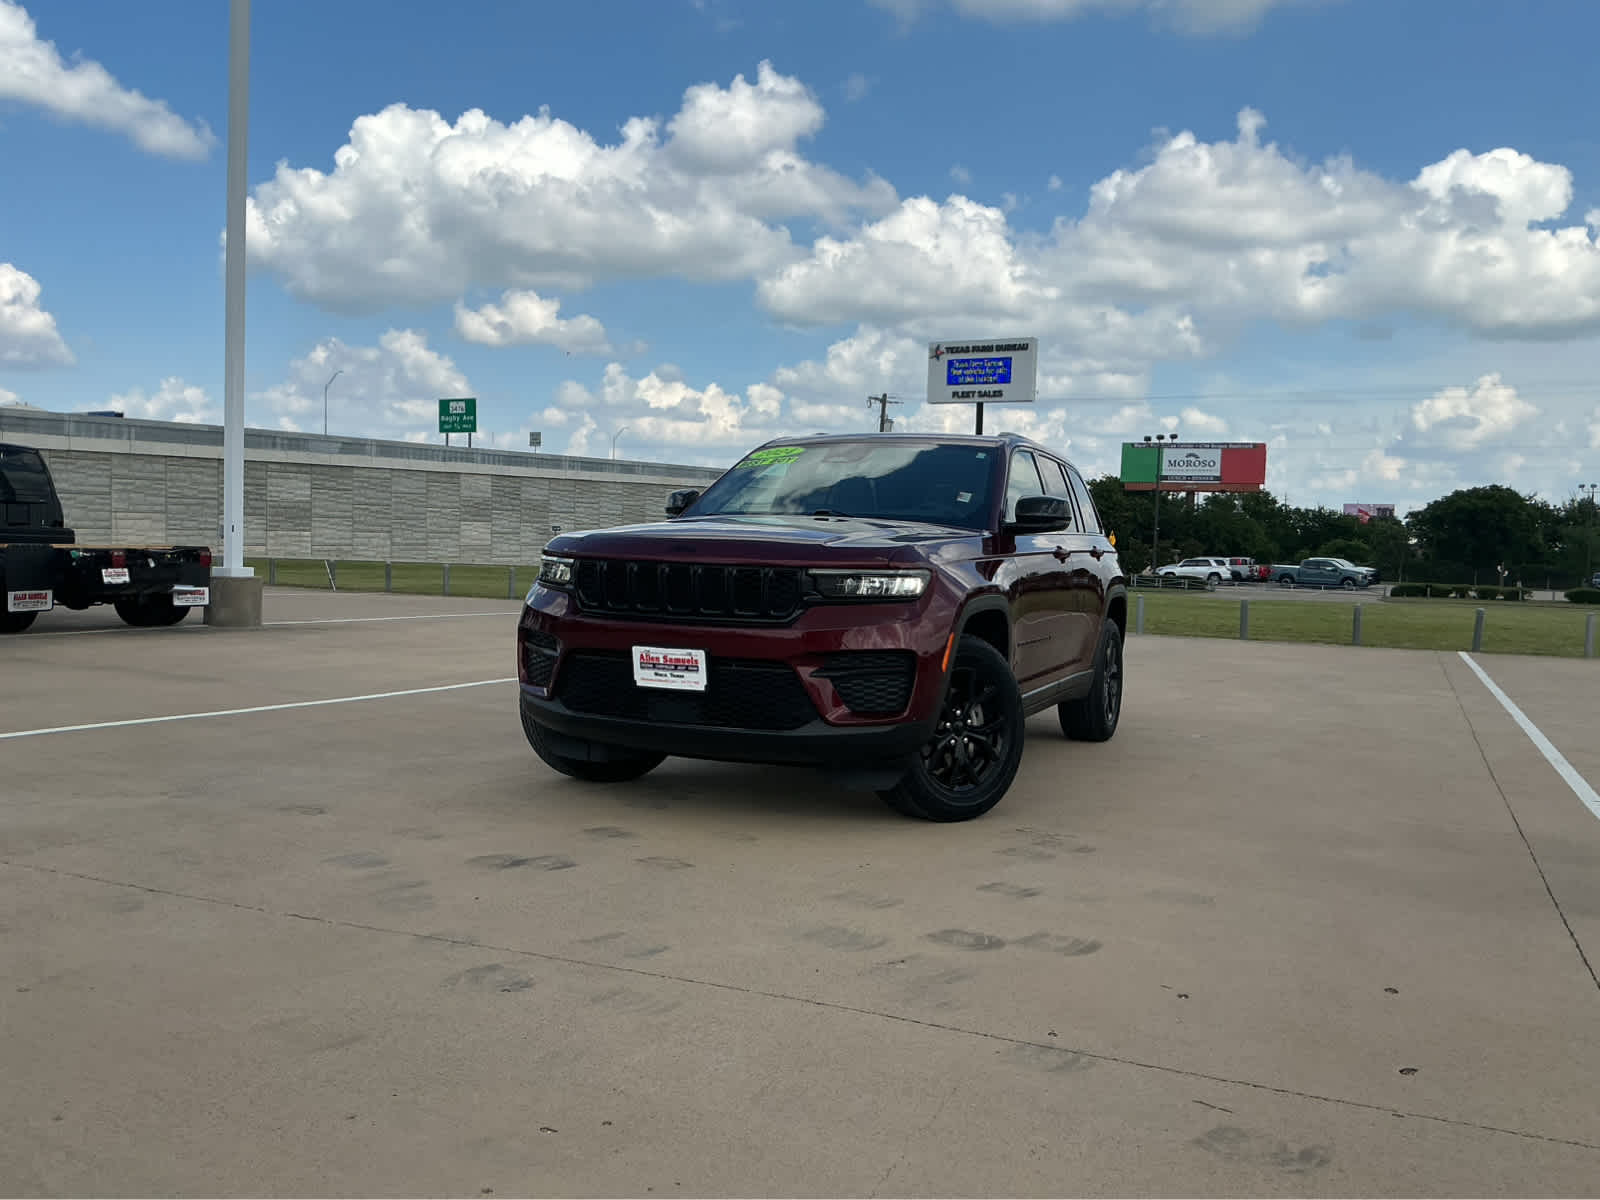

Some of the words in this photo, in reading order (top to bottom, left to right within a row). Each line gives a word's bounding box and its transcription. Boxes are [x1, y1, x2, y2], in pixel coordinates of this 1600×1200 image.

[945, 346, 970, 354] TEXAS
[972, 344, 994, 353] FARM
[995, 343, 1029, 352] BUREAU
[952, 390, 976, 399] FLEET
[978, 390, 1003, 398] SALES
[1167, 459, 1217, 468] MOROSO
[640, 653, 660, 663] Allen
[662, 655, 699, 665] Samuels
